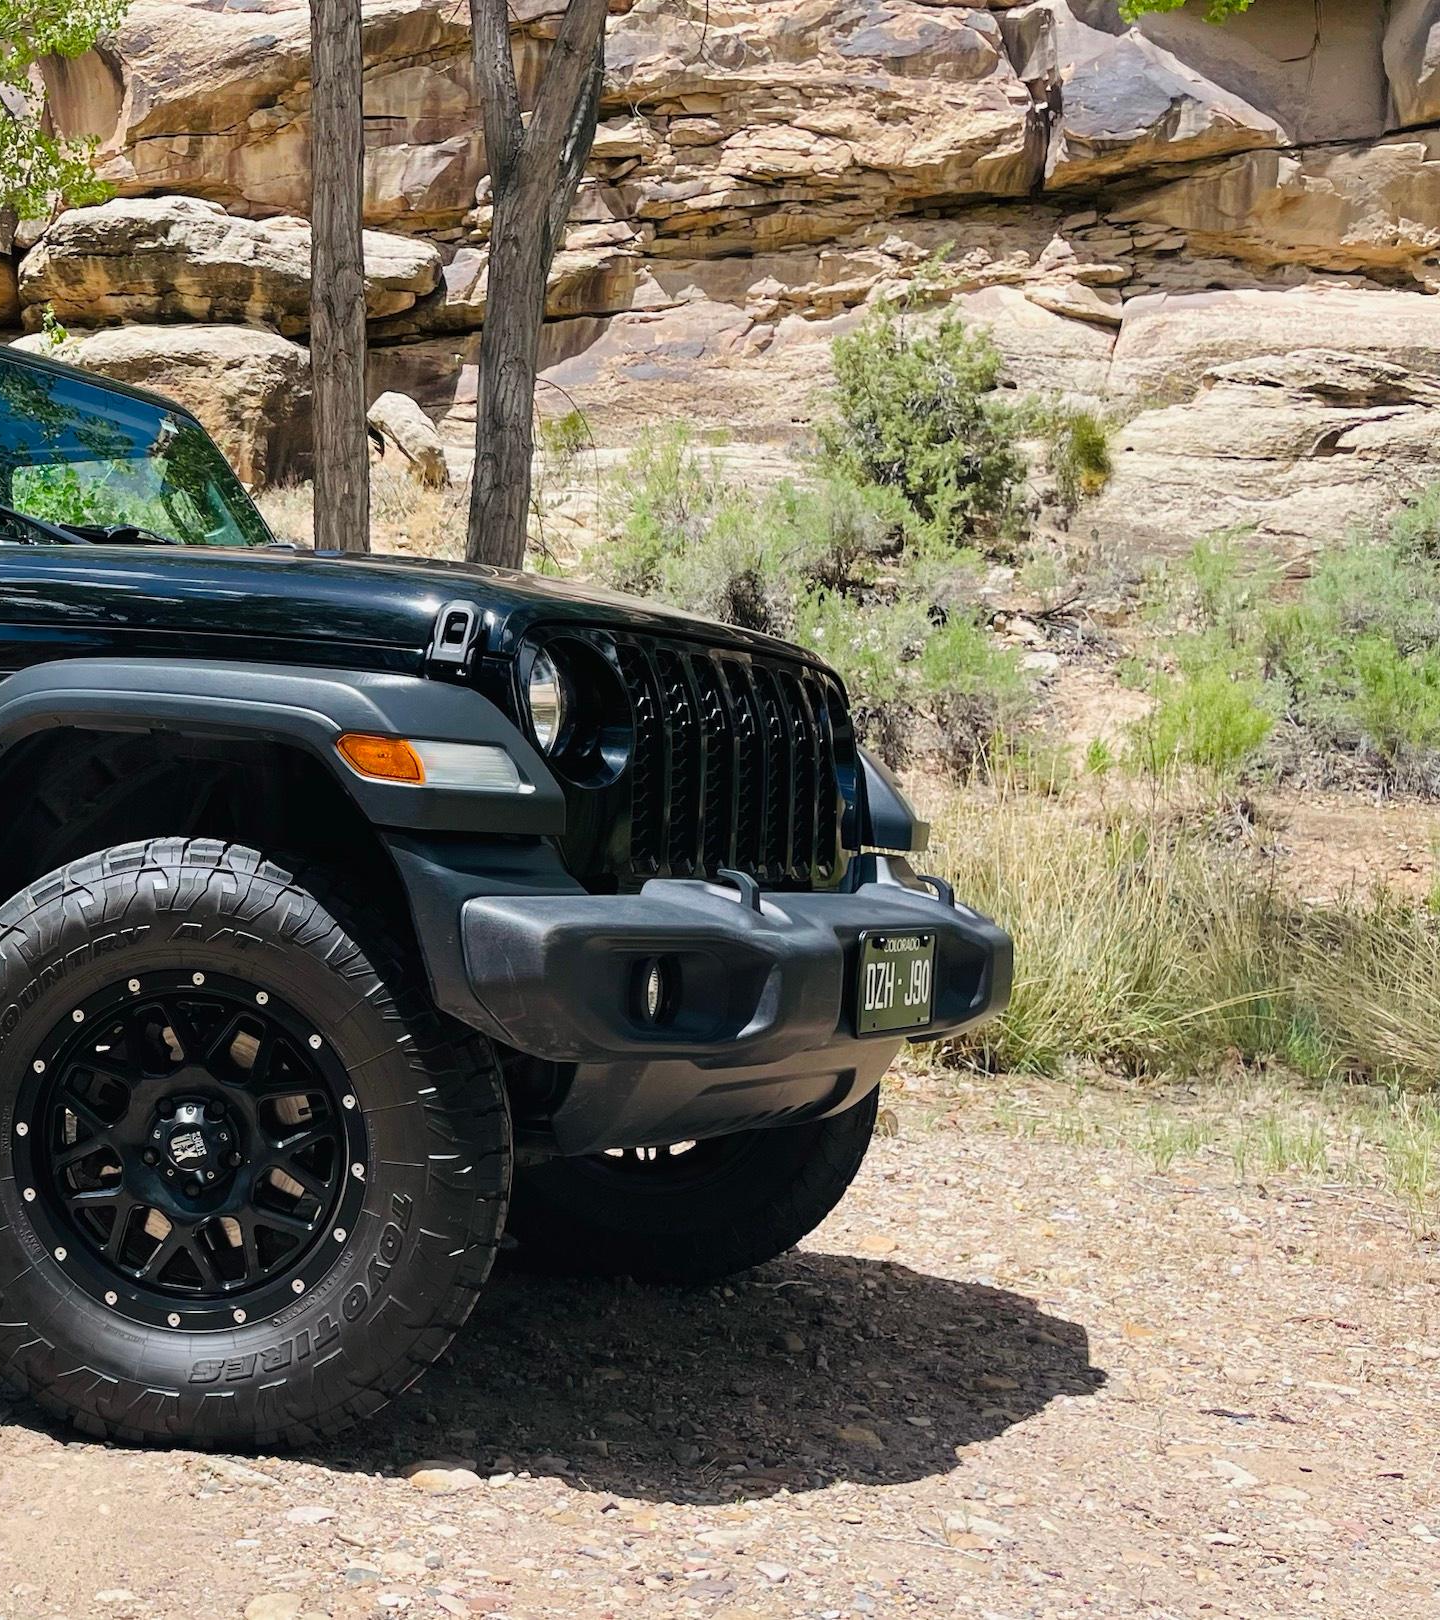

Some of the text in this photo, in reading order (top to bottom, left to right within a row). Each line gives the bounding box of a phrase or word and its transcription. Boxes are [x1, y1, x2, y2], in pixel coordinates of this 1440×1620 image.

[882, 938, 921, 953] COLORADO
[864, 959, 930, 1011] DZH J90
[341, 1192, 414, 1323] TOYO
[187, 1311, 341, 1384] TIRES
